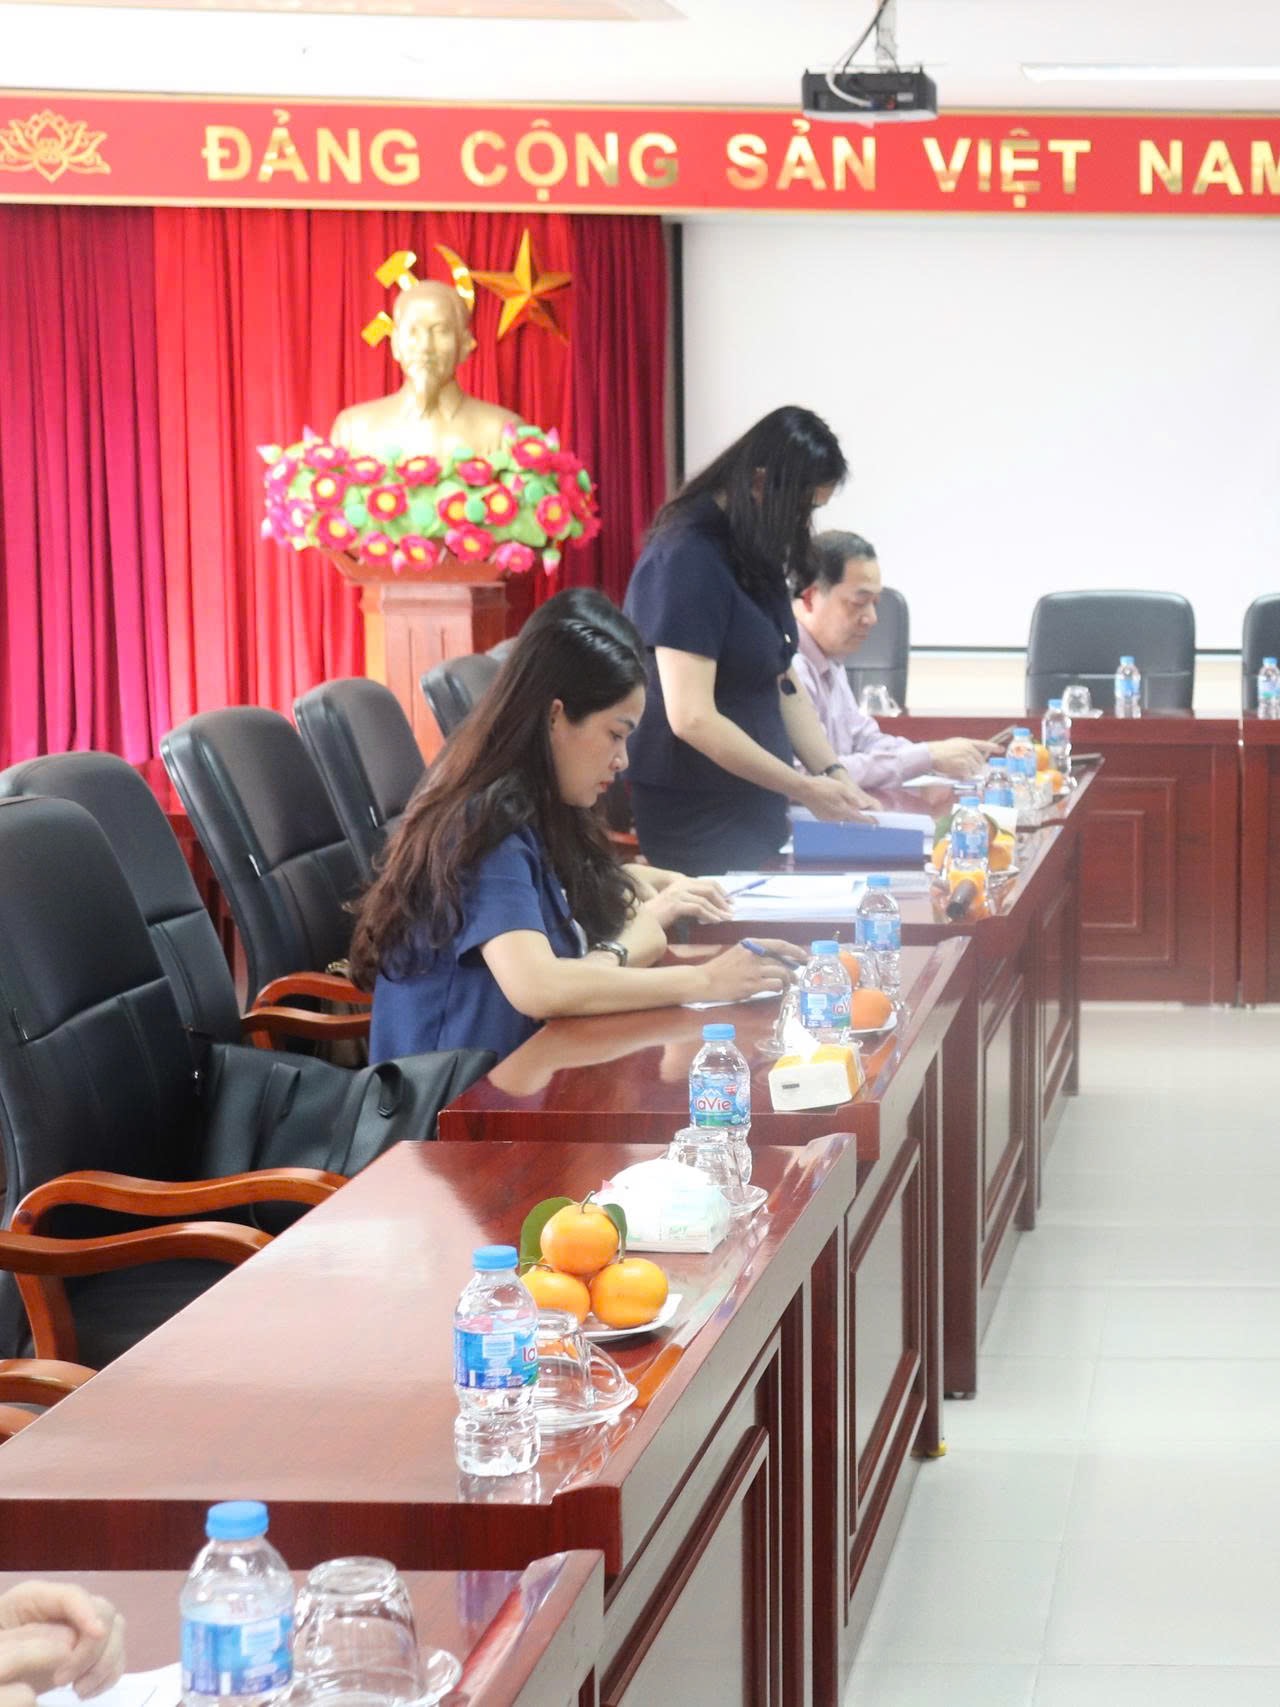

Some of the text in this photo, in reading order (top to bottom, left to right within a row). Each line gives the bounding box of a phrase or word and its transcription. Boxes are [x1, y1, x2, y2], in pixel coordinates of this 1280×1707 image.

[201, 109, 420, 186] ĐẢNG
[461, 119, 678, 203] CỘNG
[726, 118, 877, 193] SẢN
[922, 128, 1091, 208] VIỆT
